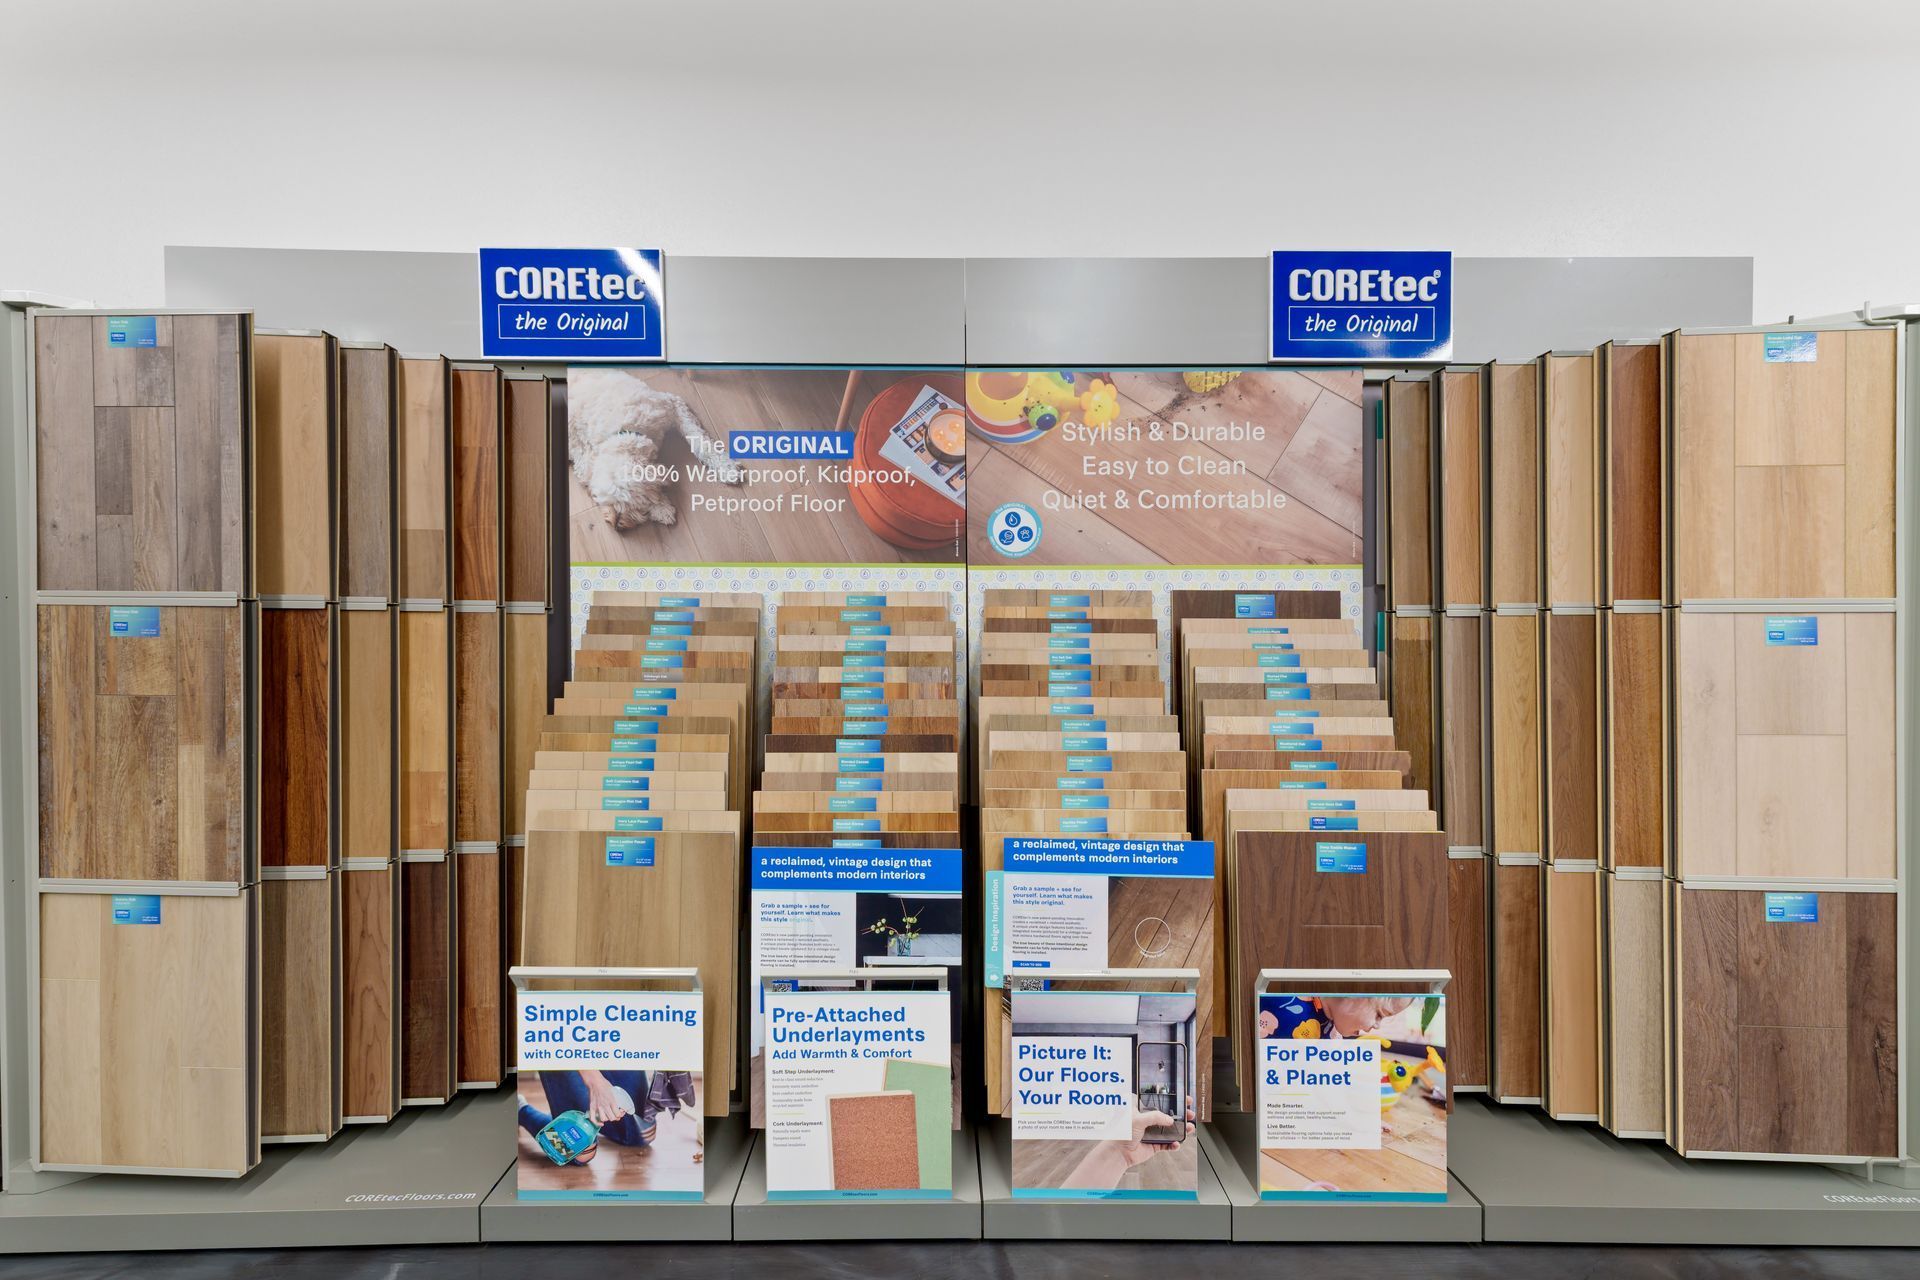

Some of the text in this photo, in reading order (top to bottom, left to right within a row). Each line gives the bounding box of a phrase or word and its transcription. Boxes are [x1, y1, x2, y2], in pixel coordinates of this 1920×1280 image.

[495, 266, 647, 301] COREtec
[515, 311, 629, 337] the Original
[1305, 313, 1419, 337] the Original
[1062, 421, 1266, 446] Stylish & Durable
[687, 435, 849, 455] The ORIGINAL
[622, 464, 917, 487] 100% Waterproof, Kidproof,
[1082, 455, 1247, 480] Easy to Clean
[690, 494, 845, 517] Petproof Floor
[1042, 489, 1287, 514] Quiet & Comfortable
[1013, 839, 1185, 853] a reclaimed, vintage design that
[761, 856, 932, 868] a reclaimed, vintage design that
[1013, 852, 1178, 864] complements modern interiors
[761, 869, 926, 880] complements modern interiors
[761, 909, 786, 917] yourself.
[991, 879, 1000, 952] Design Inspiration
[524, 1004, 697, 1027] Simple Cleaning
[772, 1006, 906, 1023] Pre-Attached
[524, 1026, 621, 1043] and Care
[772, 1027, 926, 1045] Underlayments
[524, 1049, 661, 1059] with COREtec Cleaner
[772, 1048, 912, 1060] Add Warmth & Comfort
[1018, 1044, 1112, 1060] Picture It:
[1266, 1046, 1373, 1066] For People
[1019, 1067, 1125, 1083] Our Floors.
[1266, 1069, 1351, 1086] & Planet
[1018, 1090, 1127, 1105] Your Room.
[344, 1192, 477, 1203] COREtecFloors.com
